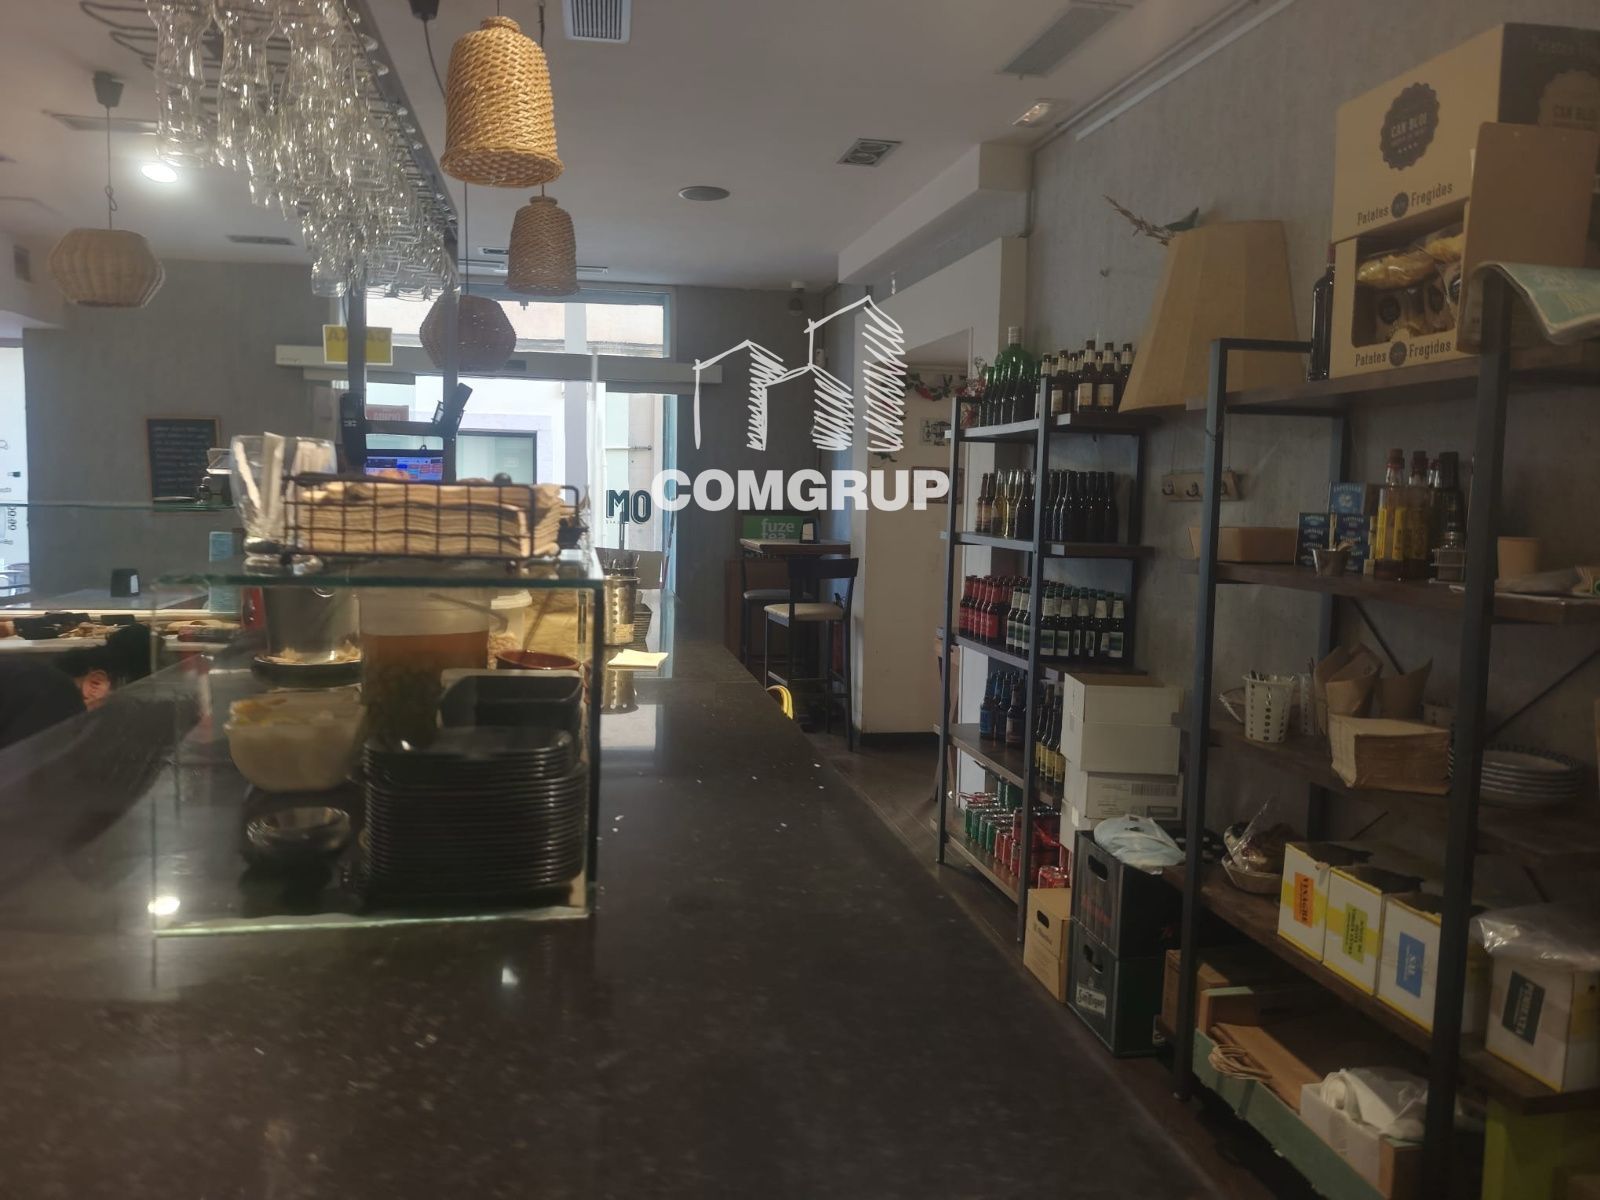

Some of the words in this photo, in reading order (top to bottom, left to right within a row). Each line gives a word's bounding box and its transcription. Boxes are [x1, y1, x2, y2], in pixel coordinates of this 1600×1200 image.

[1357, 205, 1389, 225] Patates
[1355, 351, 1386, 367] Patates
[761, 518, 795, 533] fuze
